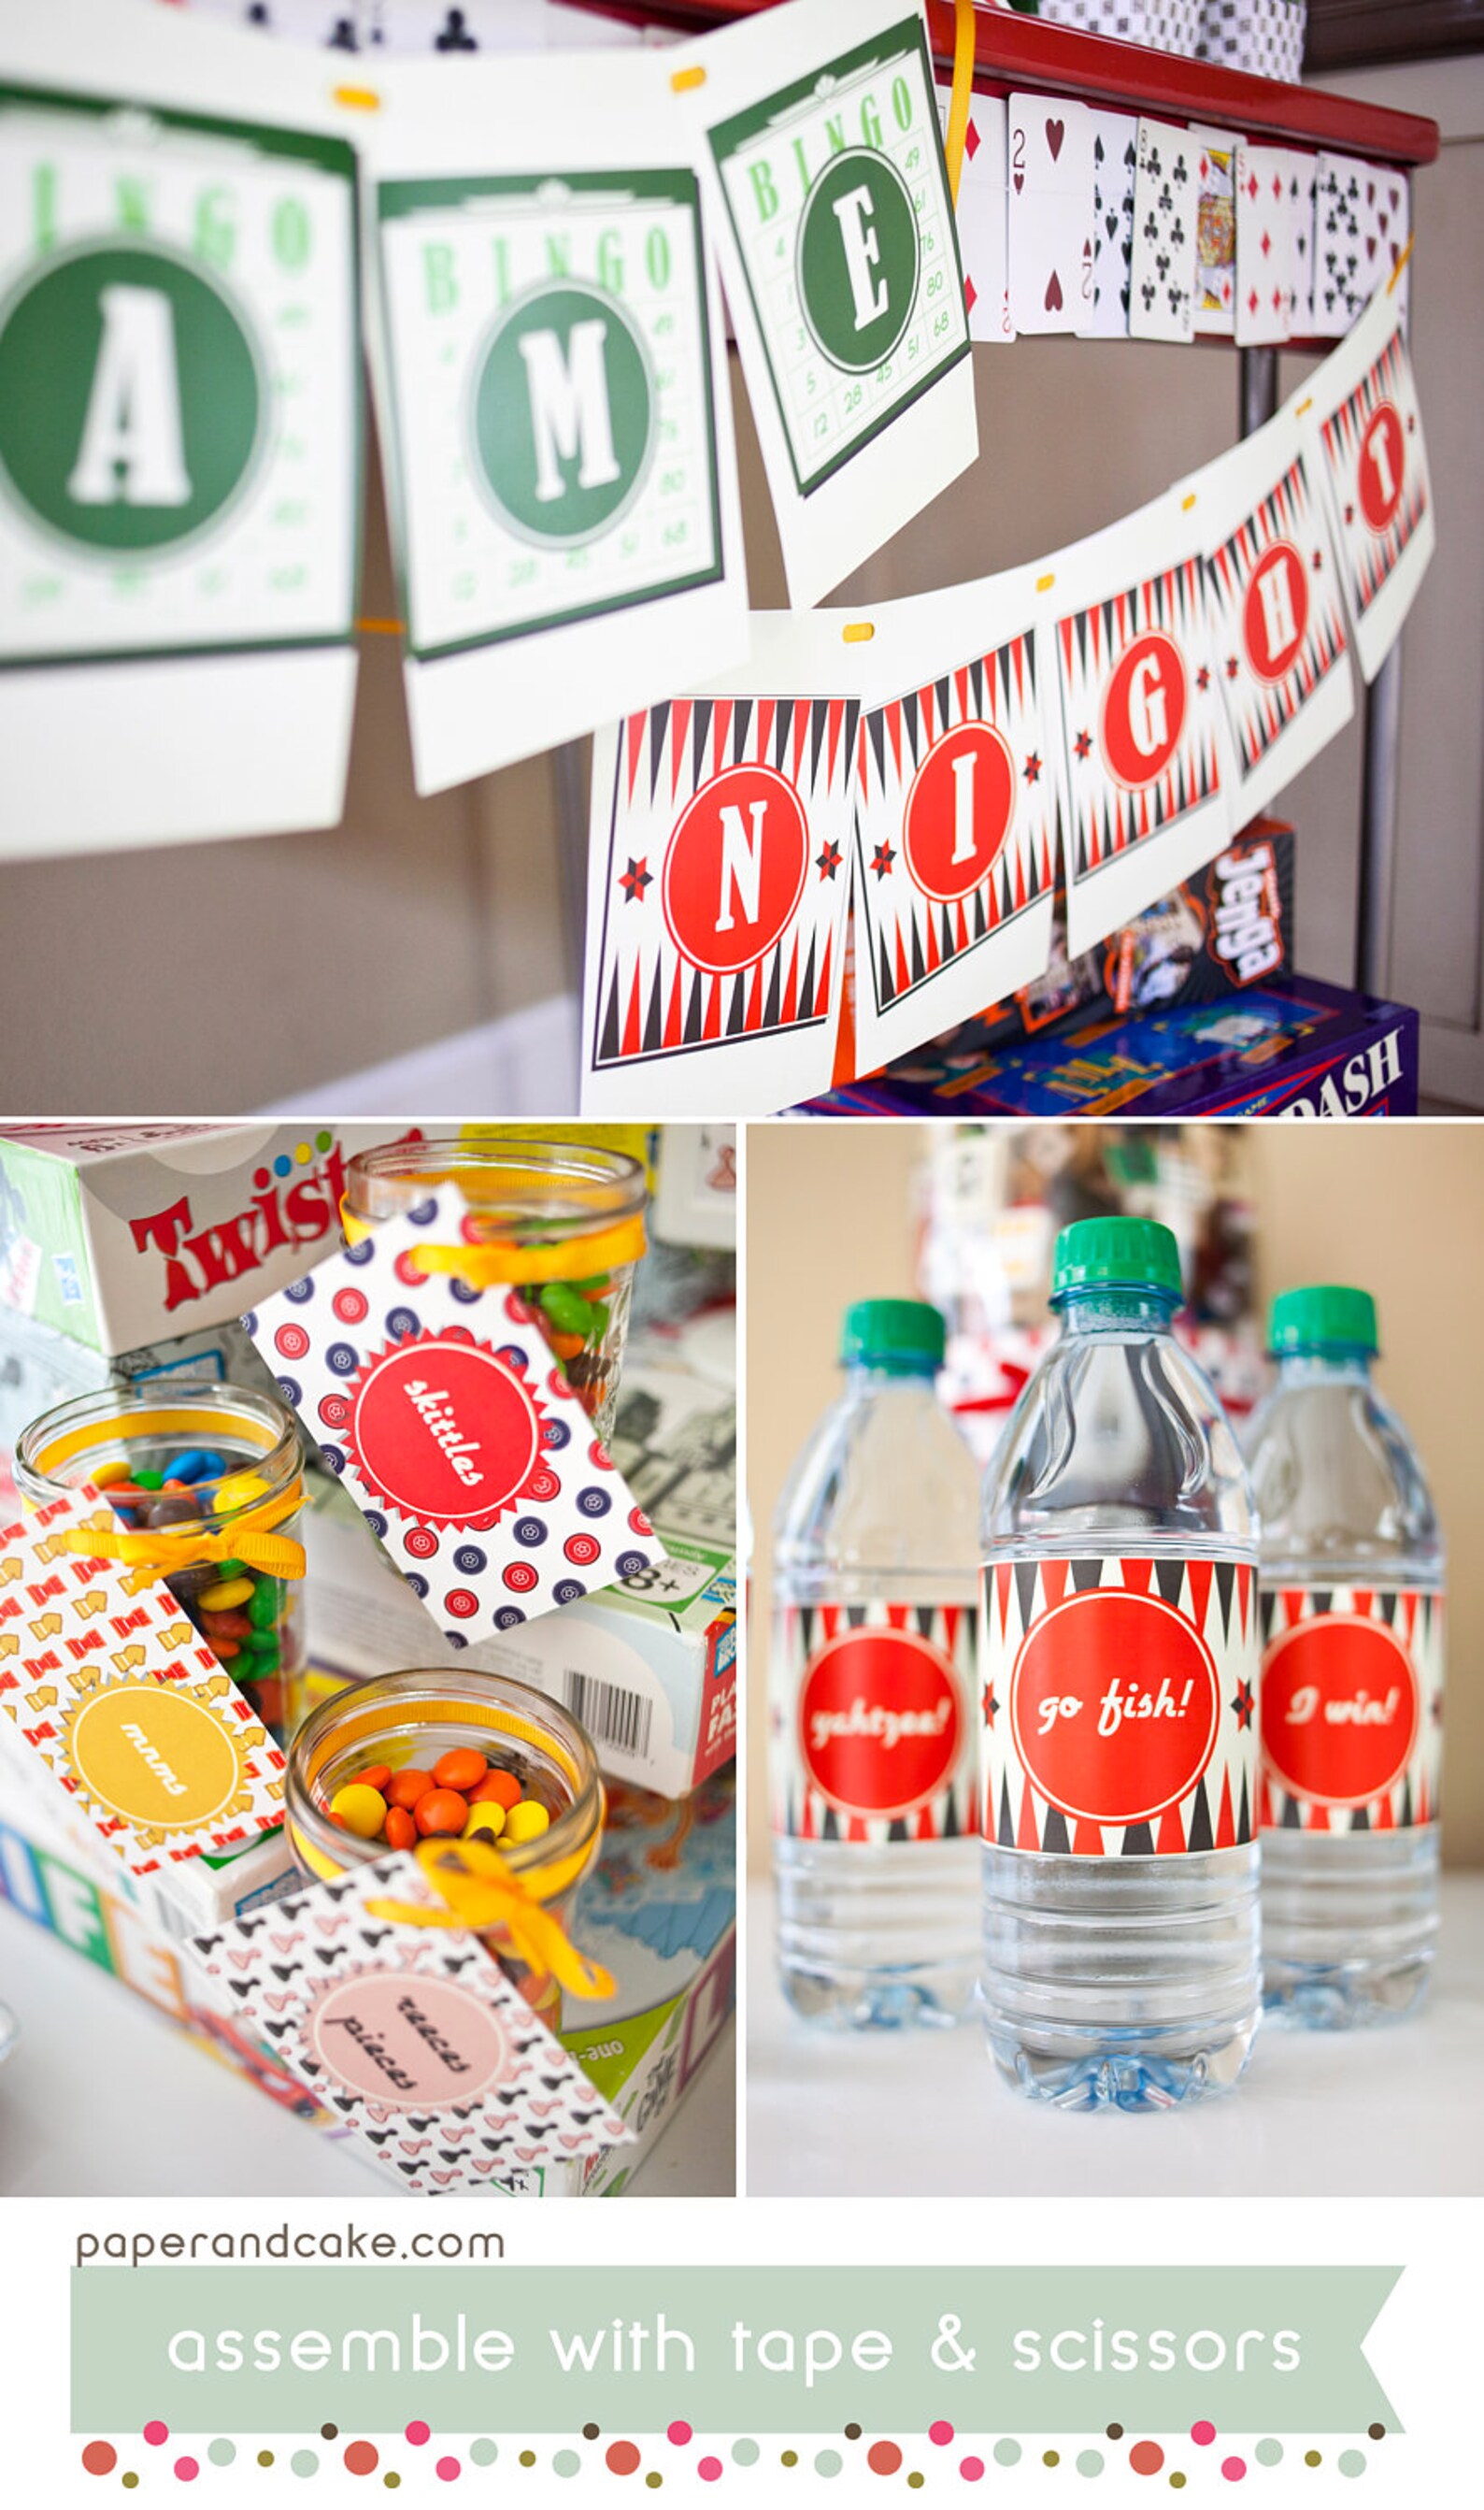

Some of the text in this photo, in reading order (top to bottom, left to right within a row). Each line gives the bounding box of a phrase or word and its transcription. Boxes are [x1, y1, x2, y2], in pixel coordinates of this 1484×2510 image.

[749, 75, 912, 223] BINGO
[905, 147, 920, 171] 49
[1013, 128, 1025, 168] 2
[833, 184, 889, 332] E
[927, 270, 943, 297] 80
[1081, 262, 1092, 299] 2
[907, 335, 920, 361] 51
[934, 310, 949, 337] 68
[68, 282, 193, 507] A
[519, 318, 621, 502] M
[806, 370, 816, 395] 5
[843, 383, 863, 414] 28
[1368, 419, 1396, 506] T
[1258, 554, 1299, 664] H
[1128, 652, 1169, 757] G
[950, 751, 980, 866] I
[714, 799, 770, 933] N
[1216, 845, 1280, 981] Jenga
[129, 1135, 355, 1312] Twist
[404, 1379, 484, 1486] skittles
[621, 1569, 681, 1591] 8+
[810, 1697, 953, 1749] yahtzee!
[1037, 1679, 1194, 1736] go fish!
[1284, 1687, 1400, 1726] I win!
[120, 1722, 188, 1797] mnms
[323, 2015, 418, 2092] pieces
[396, 1995, 471, 2074] reeces
[564, 2039, 625, 2062] one-
